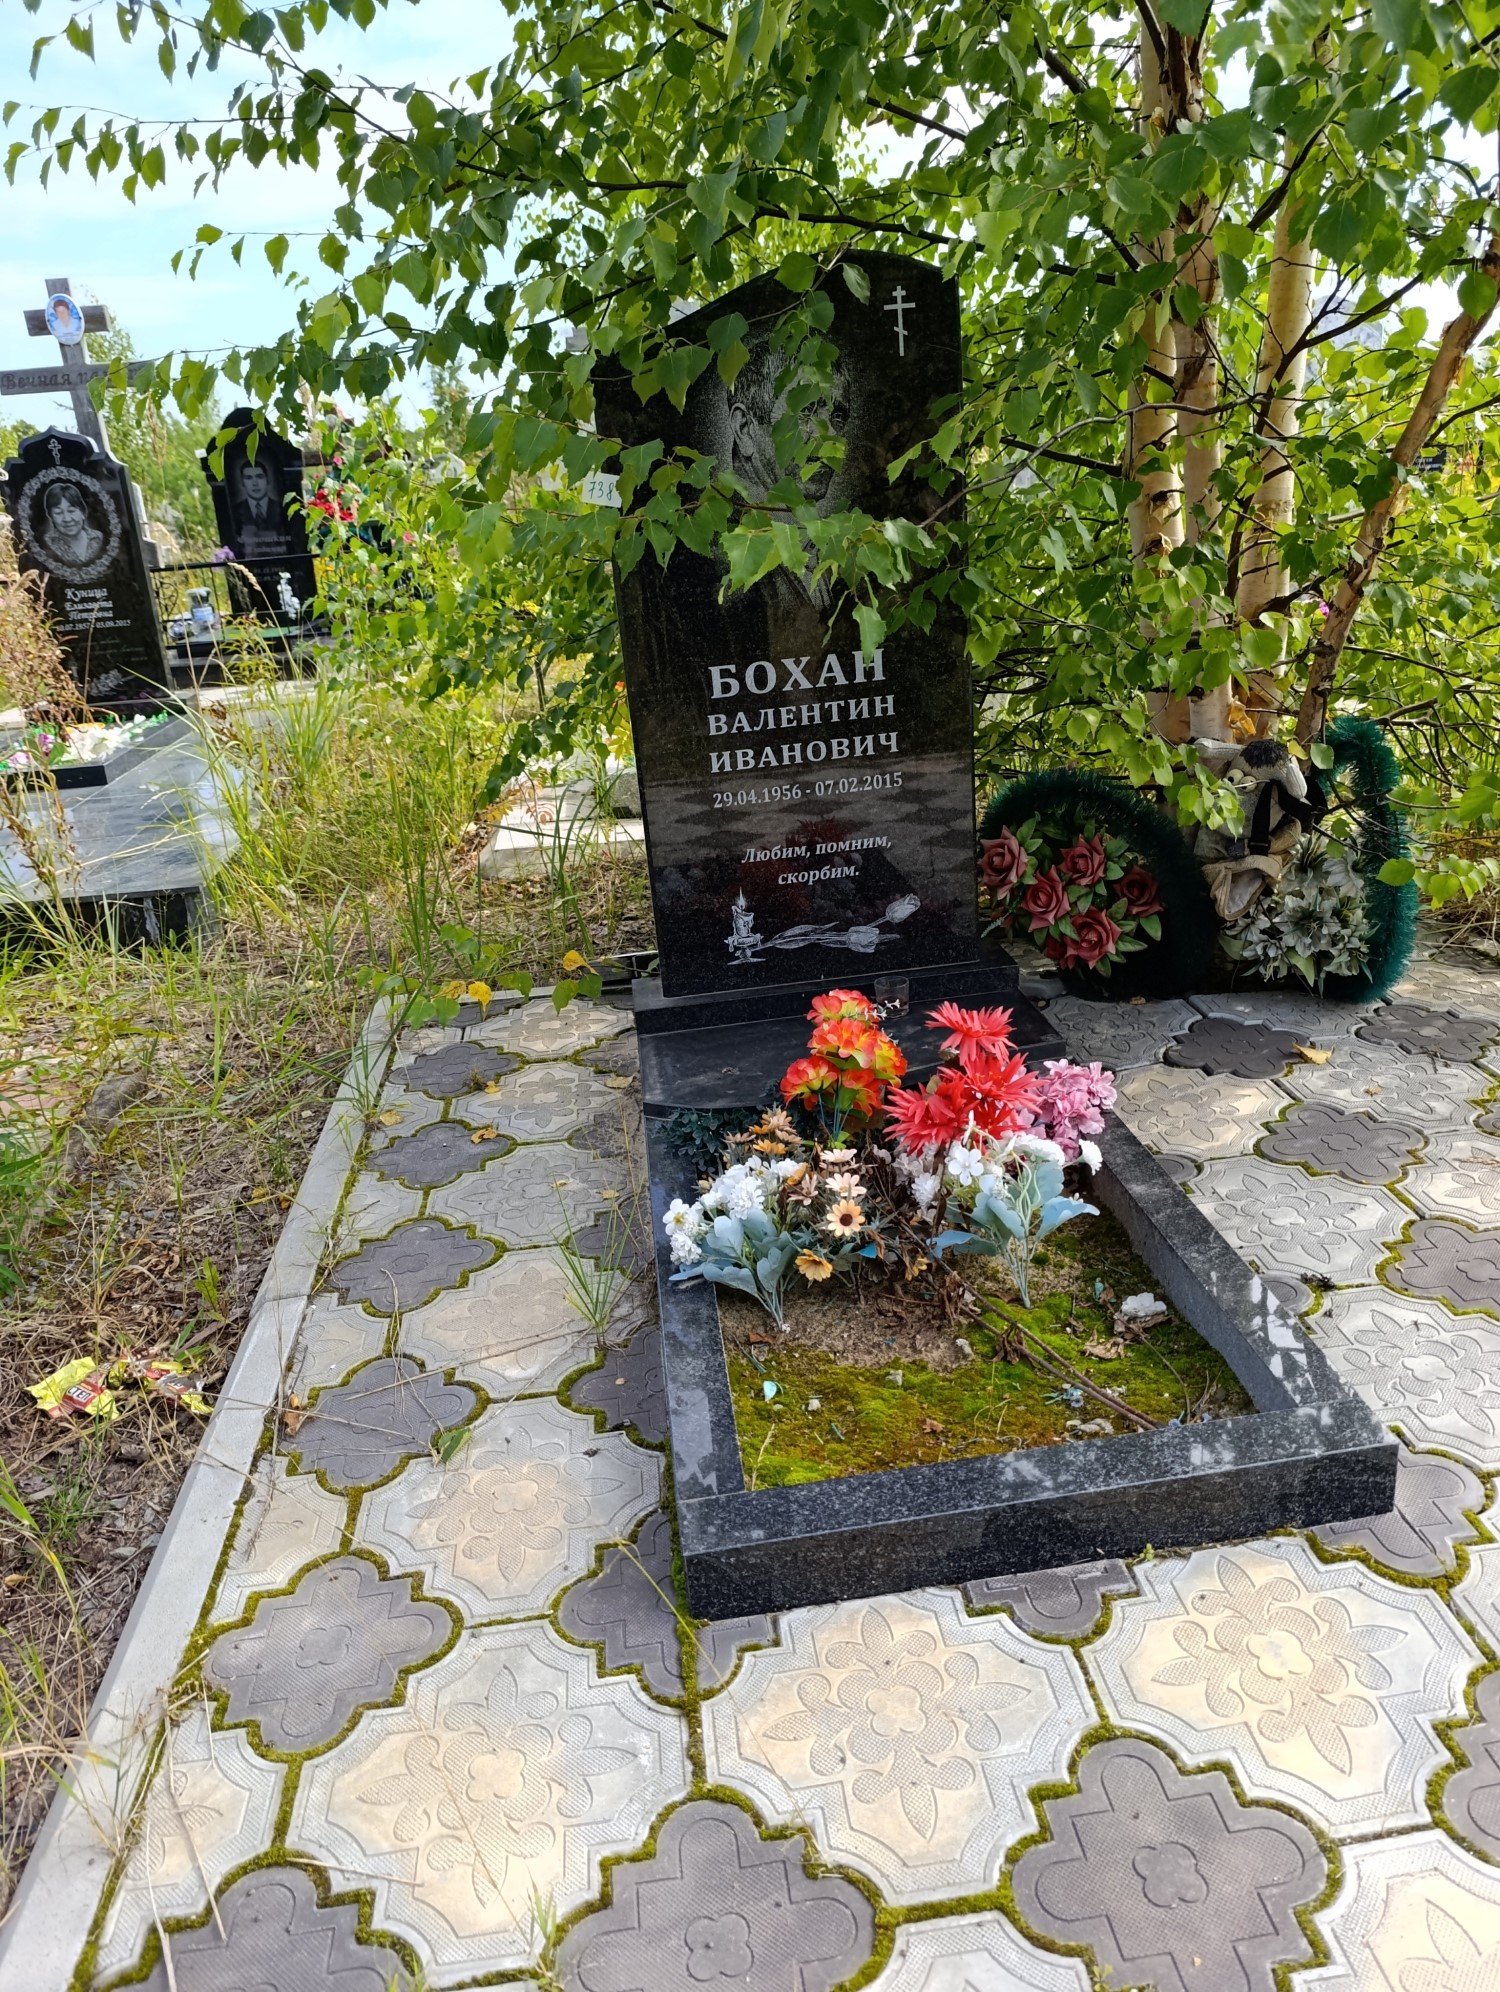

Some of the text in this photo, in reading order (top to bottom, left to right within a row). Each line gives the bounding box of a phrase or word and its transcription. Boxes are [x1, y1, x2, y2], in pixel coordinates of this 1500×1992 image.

[2, 372, 72, 390] Вечная
[588, 481, 615, 501] 738
[65, 588, 108, 602] Куница
[708, 648, 886, 699] БОХАН
[707, 695, 895, 736] ВАЛЕНТИН
[709, 732, 899, 773] ИВАНОВИЧ
[713, 784, 801, 809] 29.04.1956
[815, 771, 903, 796] 07.02.2015
[741, 834, 892, 864] Любим, помним,
[778, 868, 859, 885] скорбим.
